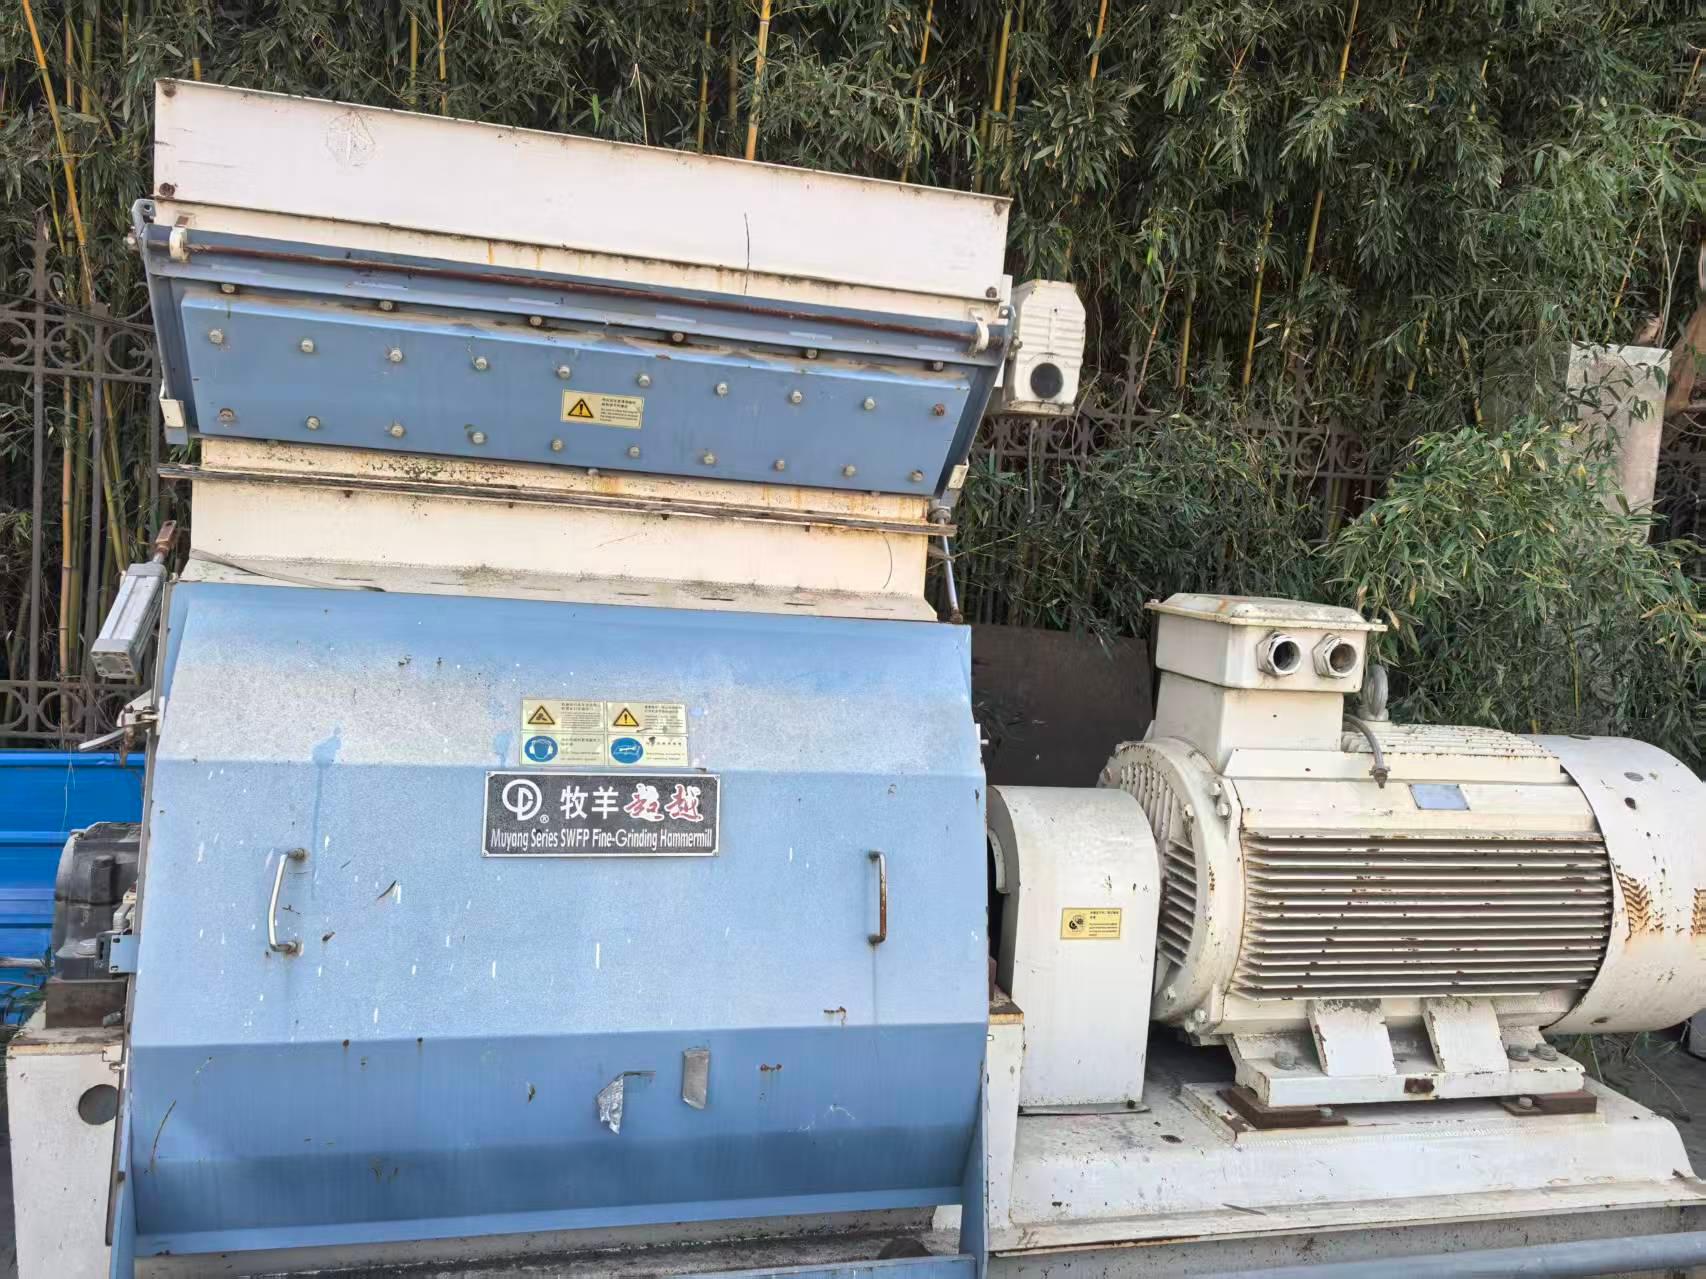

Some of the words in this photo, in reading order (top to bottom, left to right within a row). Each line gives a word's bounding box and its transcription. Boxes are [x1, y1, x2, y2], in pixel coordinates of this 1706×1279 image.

[490, 828, 529, 851] Muyang
[531, 828, 559, 848] Series
[560, 828, 590, 848] SWFP
[592, 828, 658, 851] Fine-Grinding
[660, 828, 713, 848] Hammermill
